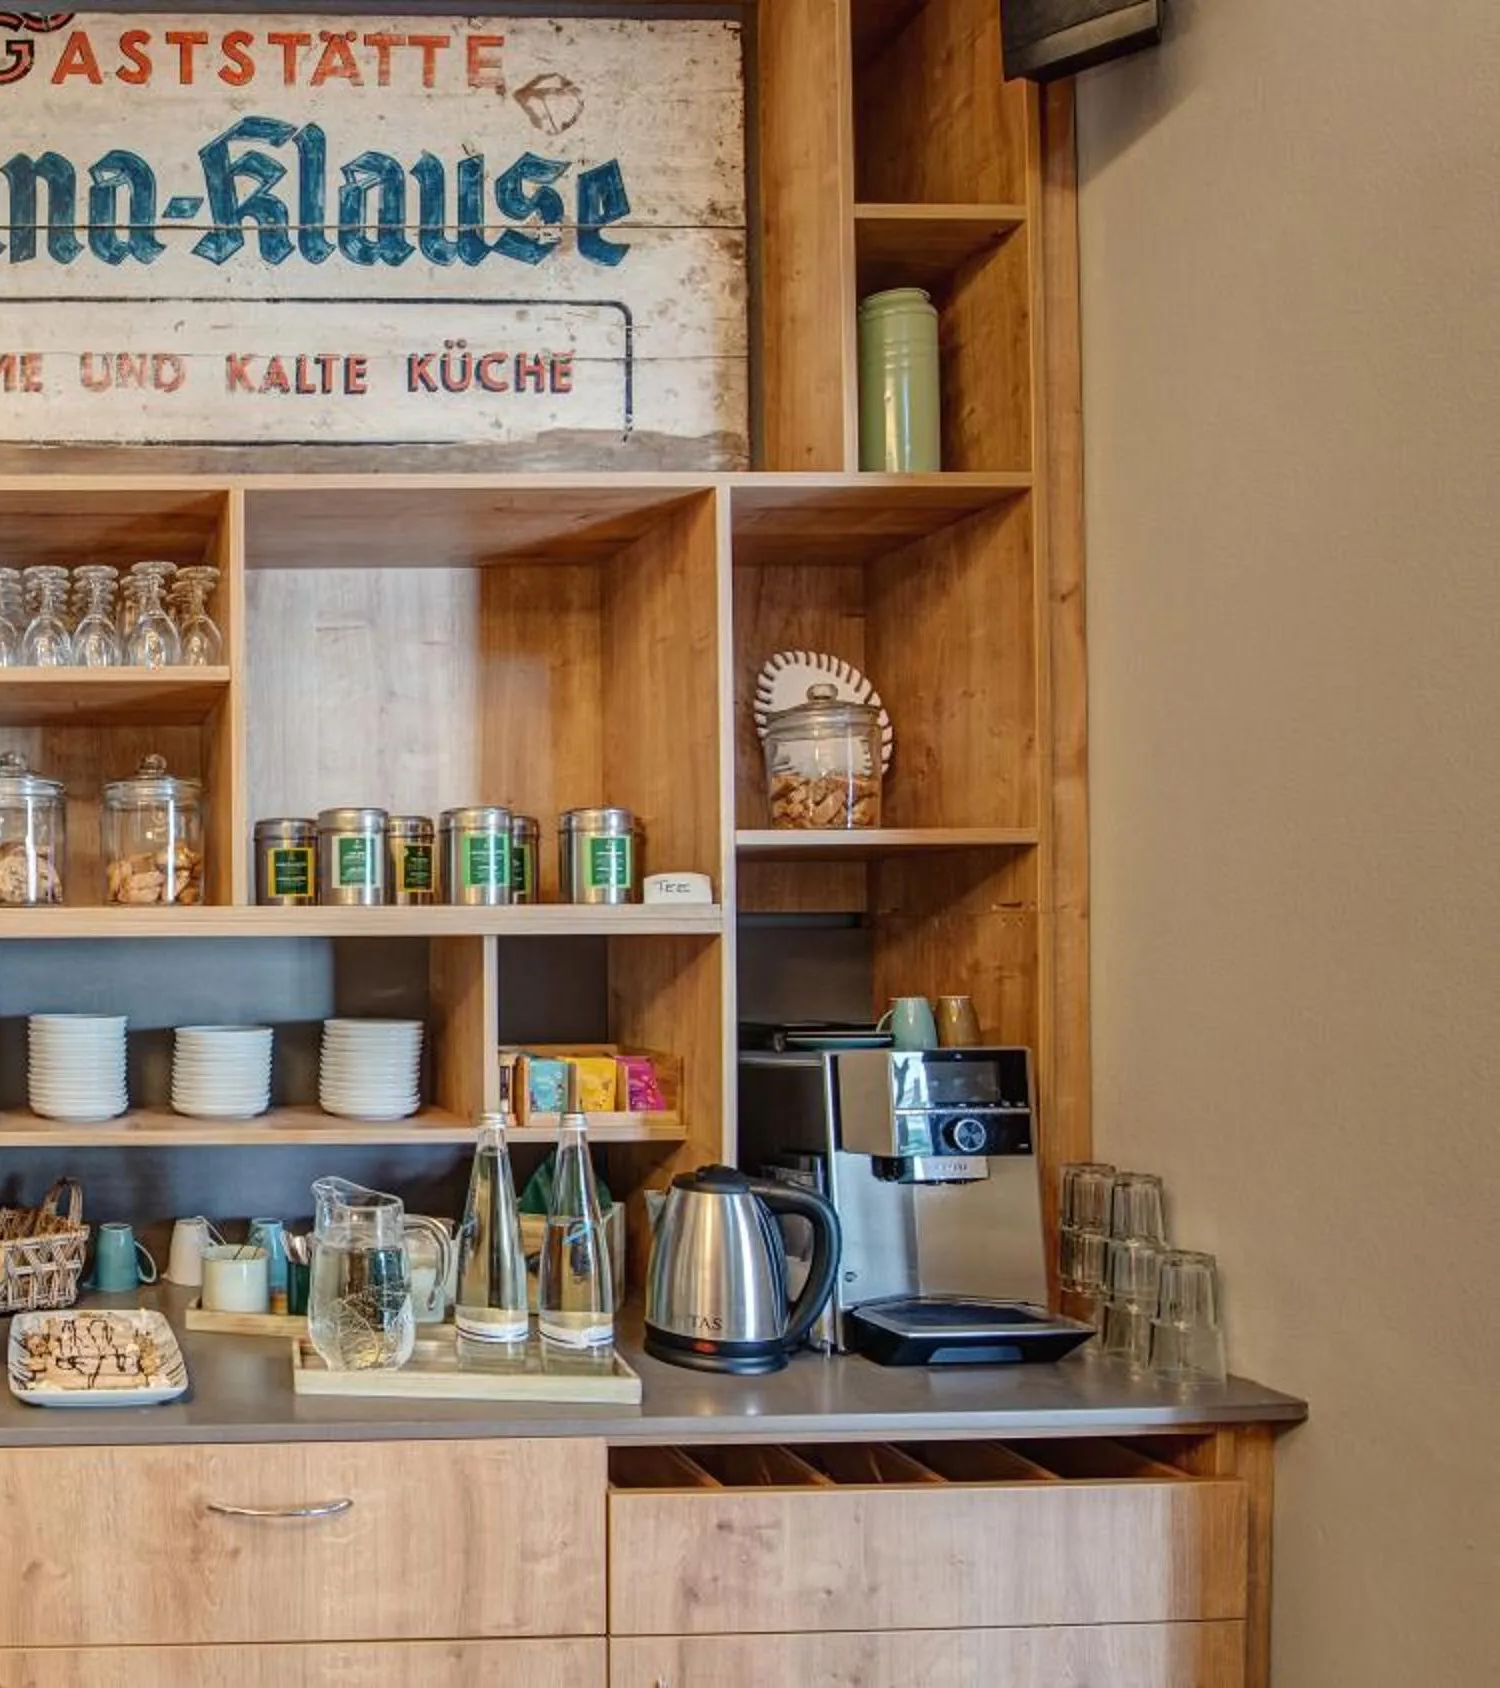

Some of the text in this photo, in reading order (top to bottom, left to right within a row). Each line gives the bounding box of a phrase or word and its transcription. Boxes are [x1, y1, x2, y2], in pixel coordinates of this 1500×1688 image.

[79, 350, 187, 393] UND
[225, 350, 368, 395] KALTE
[406, 338, 576, 394] KÜCHE
